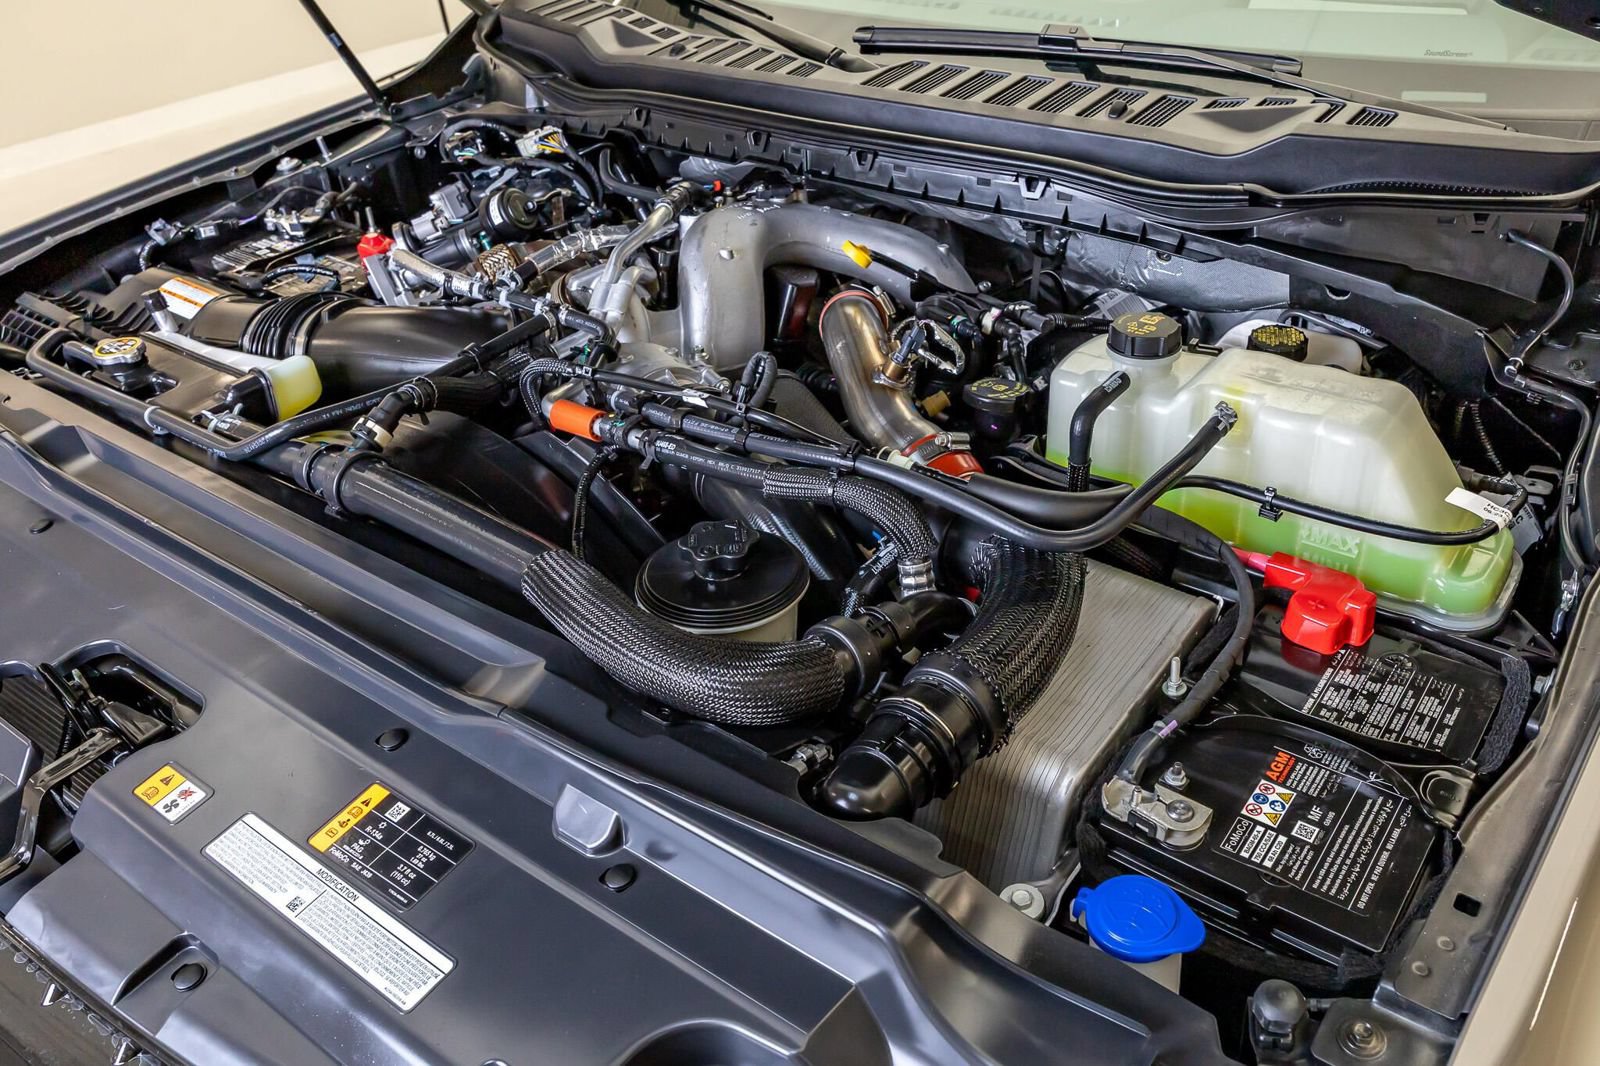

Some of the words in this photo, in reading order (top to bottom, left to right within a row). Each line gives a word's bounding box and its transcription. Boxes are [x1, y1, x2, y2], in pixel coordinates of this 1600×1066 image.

[1264, 750, 1290, 781] AGM
[1307, 804, 1324, 822] MF
[1224, 818, 1249, 852] FoMoCo
[325, 847, 352, 863] FoMoCo
[349, 842, 365, 853] PAG
[316, 868, 359, 902] MODIFICATION
